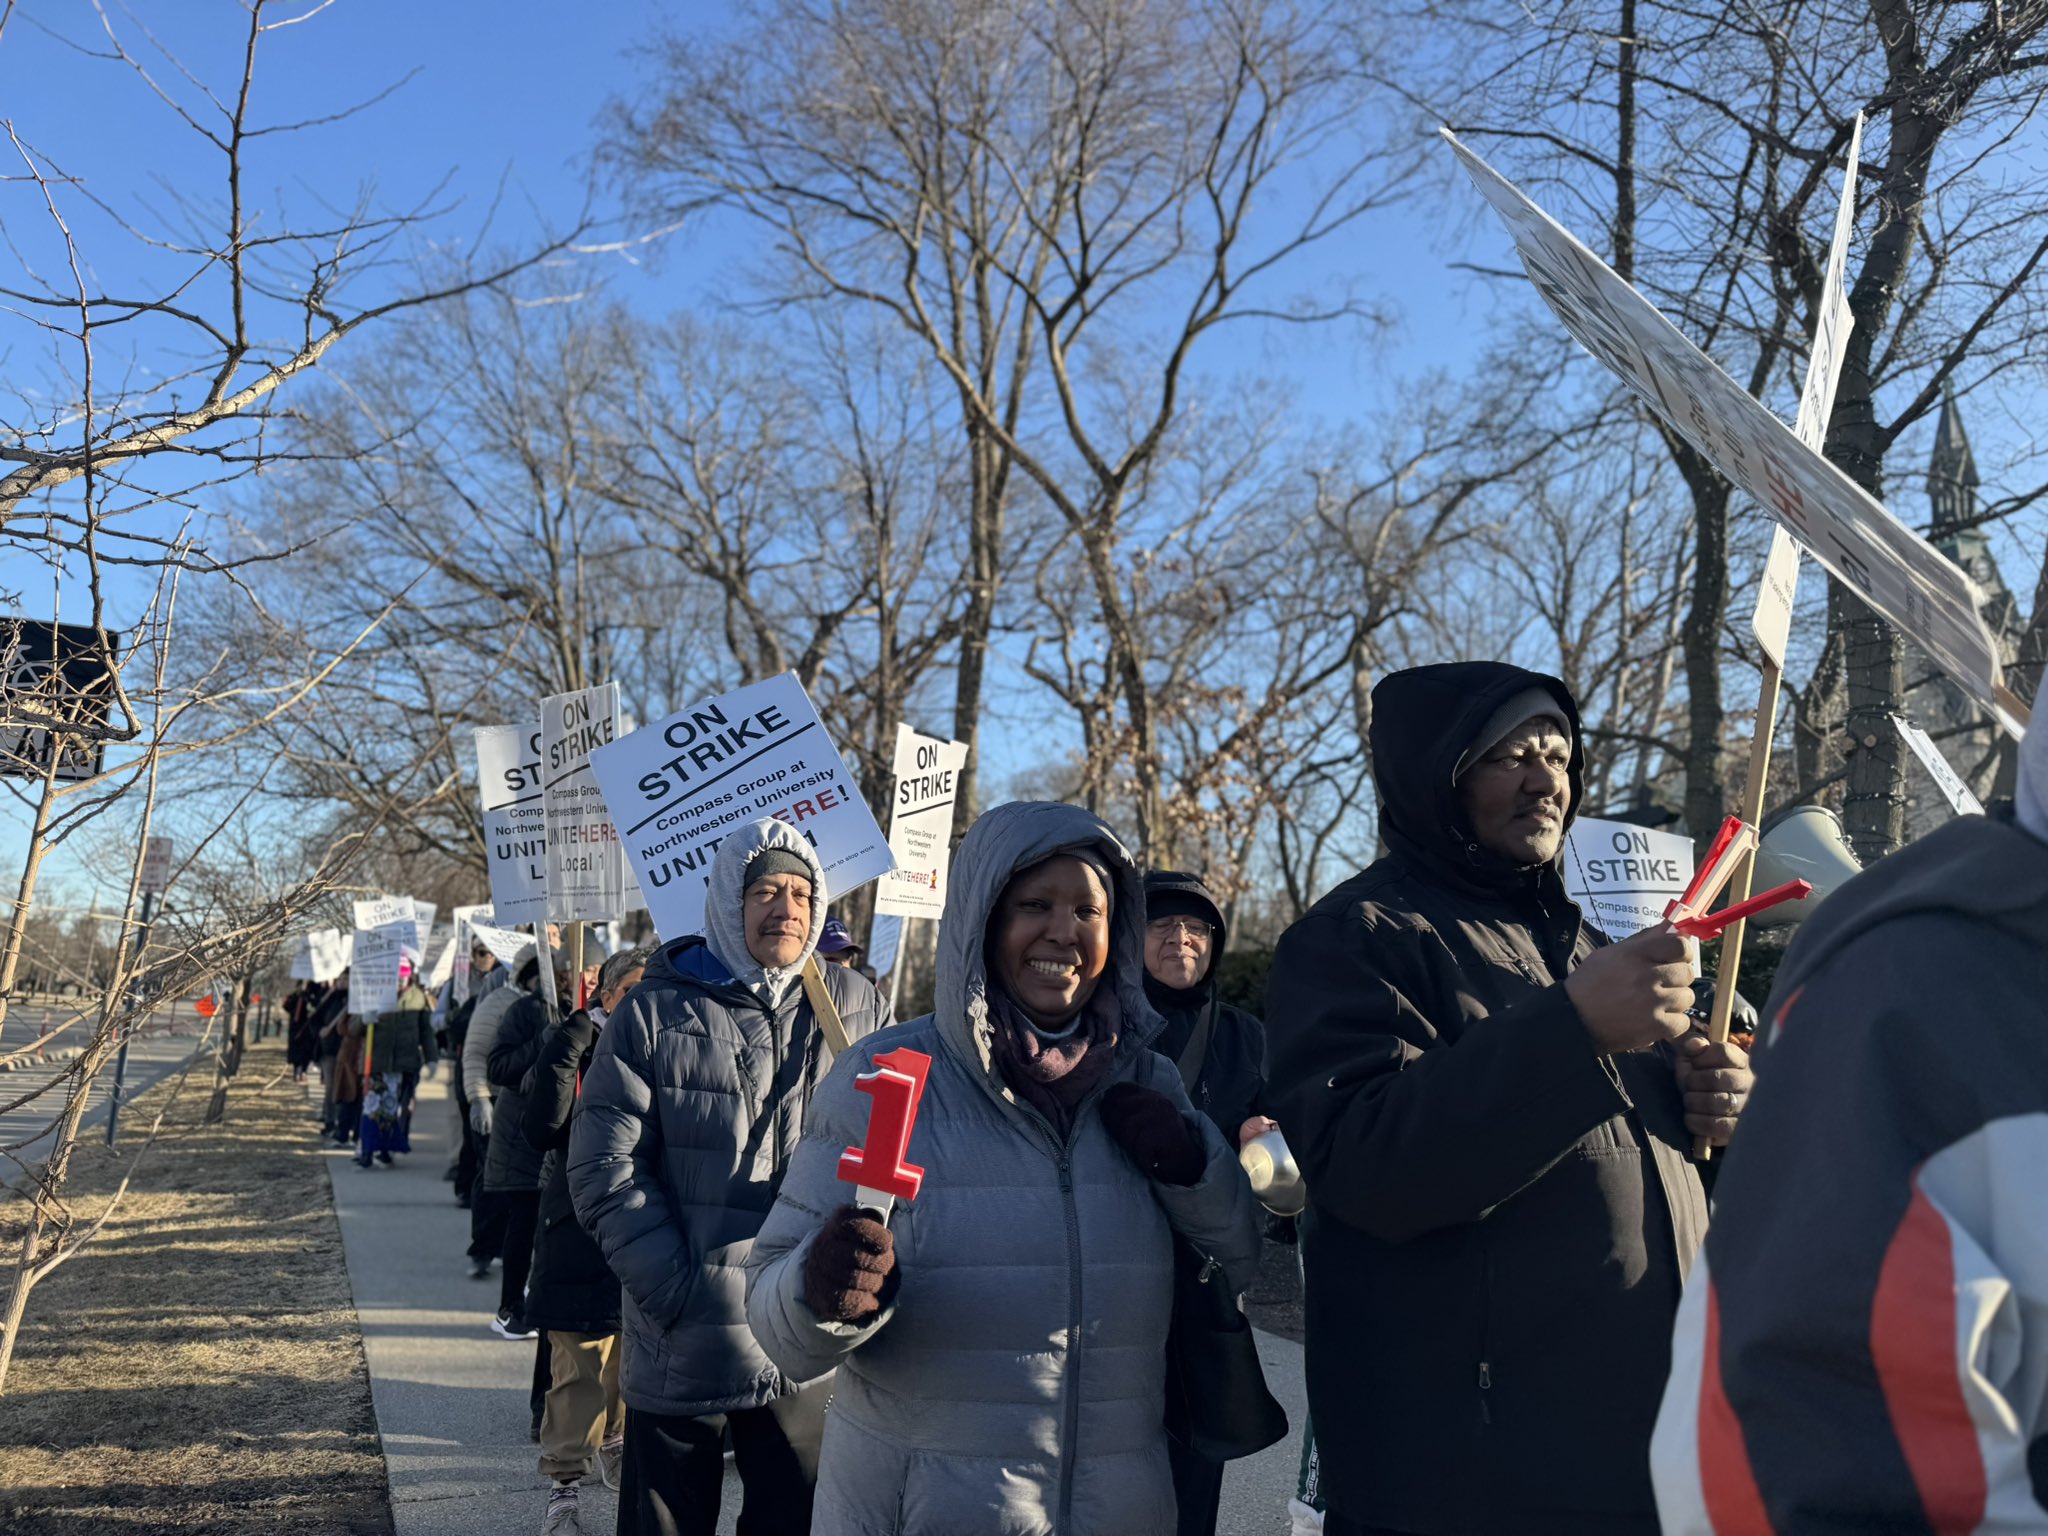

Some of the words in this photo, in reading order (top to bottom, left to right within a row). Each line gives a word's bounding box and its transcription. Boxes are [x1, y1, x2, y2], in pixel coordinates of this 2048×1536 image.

[563, 695, 590, 730] ON
[663, 703, 729, 749] ON
[550, 717, 614, 770] STRIKE
[638, 704, 791, 800] STRIKE
[916, 743, 938, 770] ON
[552, 787, 579, 801] Compass
[580, 785, 602, 799] Grou
[656, 791, 734, 831] Compass
[736, 766, 788, 796] Group
[790, 759, 807, 774] at
[899, 770, 952, 805] STRIKE
[509, 807, 544, 818] Comp
[585, 803, 609, 816] Unive
[641, 804, 752, 861] Northwestern
[753, 768, 836, 809] University
[495, 822, 545, 836] Northwe
[803, 829, 819, 849] 1
[904, 826, 922, 837] Compass
[922, 830, 932, 840] Group
[845, 852, 860, 862] stop
[859, 845, 875, 855] work
[907, 838, 931, 849] Northwestern
[1611, 832, 1651, 855] ON
[559, 851, 593, 872] Local
[598, 854, 606, 870] 1
[908, 849, 927, 860] University
[1586, 859, 1681, 883] STRIKE
[365, 907, 406, 926] STRIKE
[374, 901, 391, 913] ON
[1591, 899, 1640, 914] Compass
[1642, 906, 1665, 919] Grou
[1584, 916, 1647, 930] orthwestern
